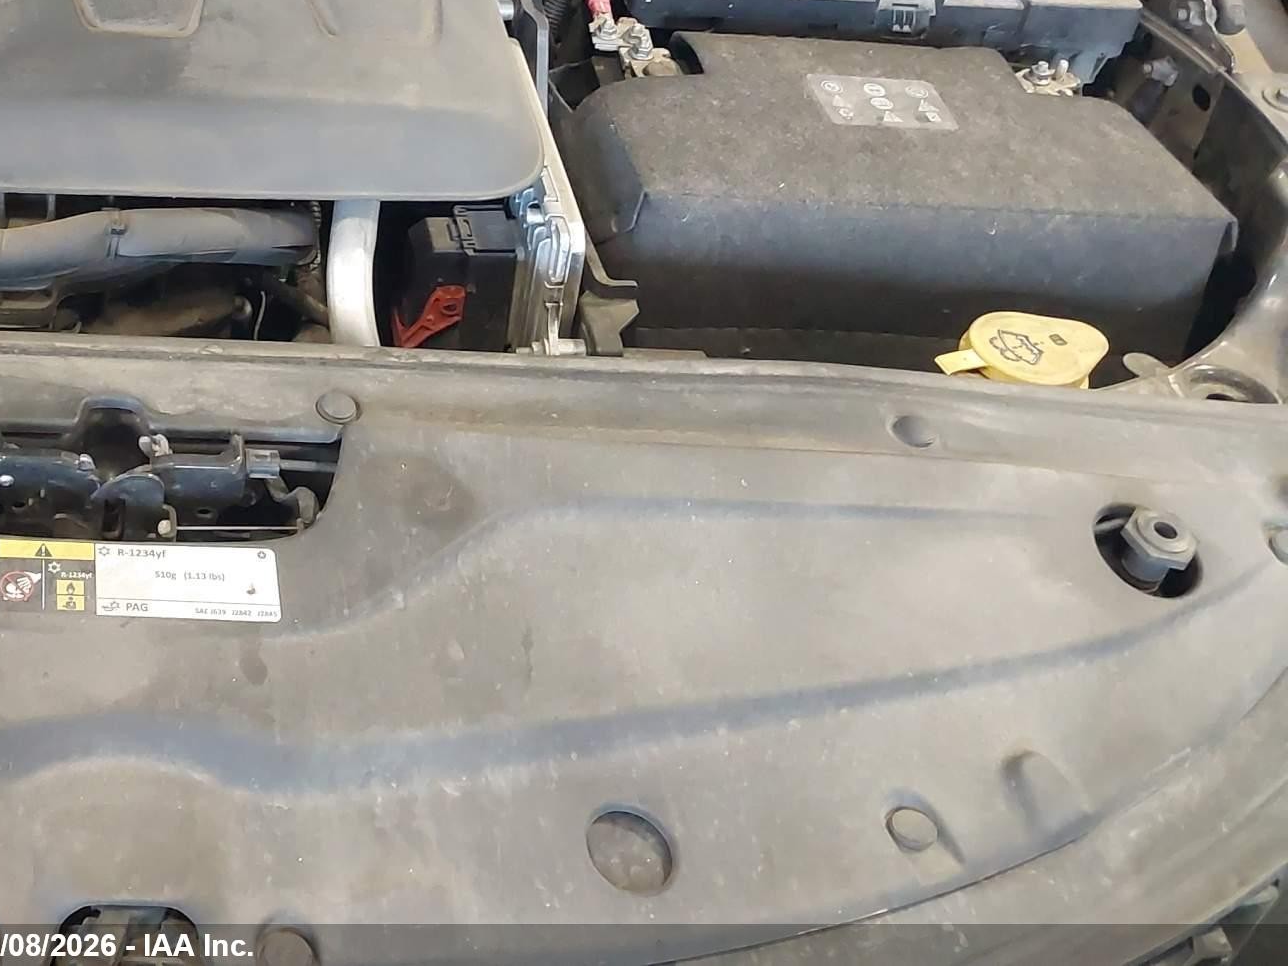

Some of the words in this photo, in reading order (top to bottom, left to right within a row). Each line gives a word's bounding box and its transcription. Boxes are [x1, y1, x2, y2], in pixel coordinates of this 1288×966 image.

[117, 547, 166, 559] R-1234yf
[154, 570, 177, 580] 510g
[125, 602, 149, 612] PAG
